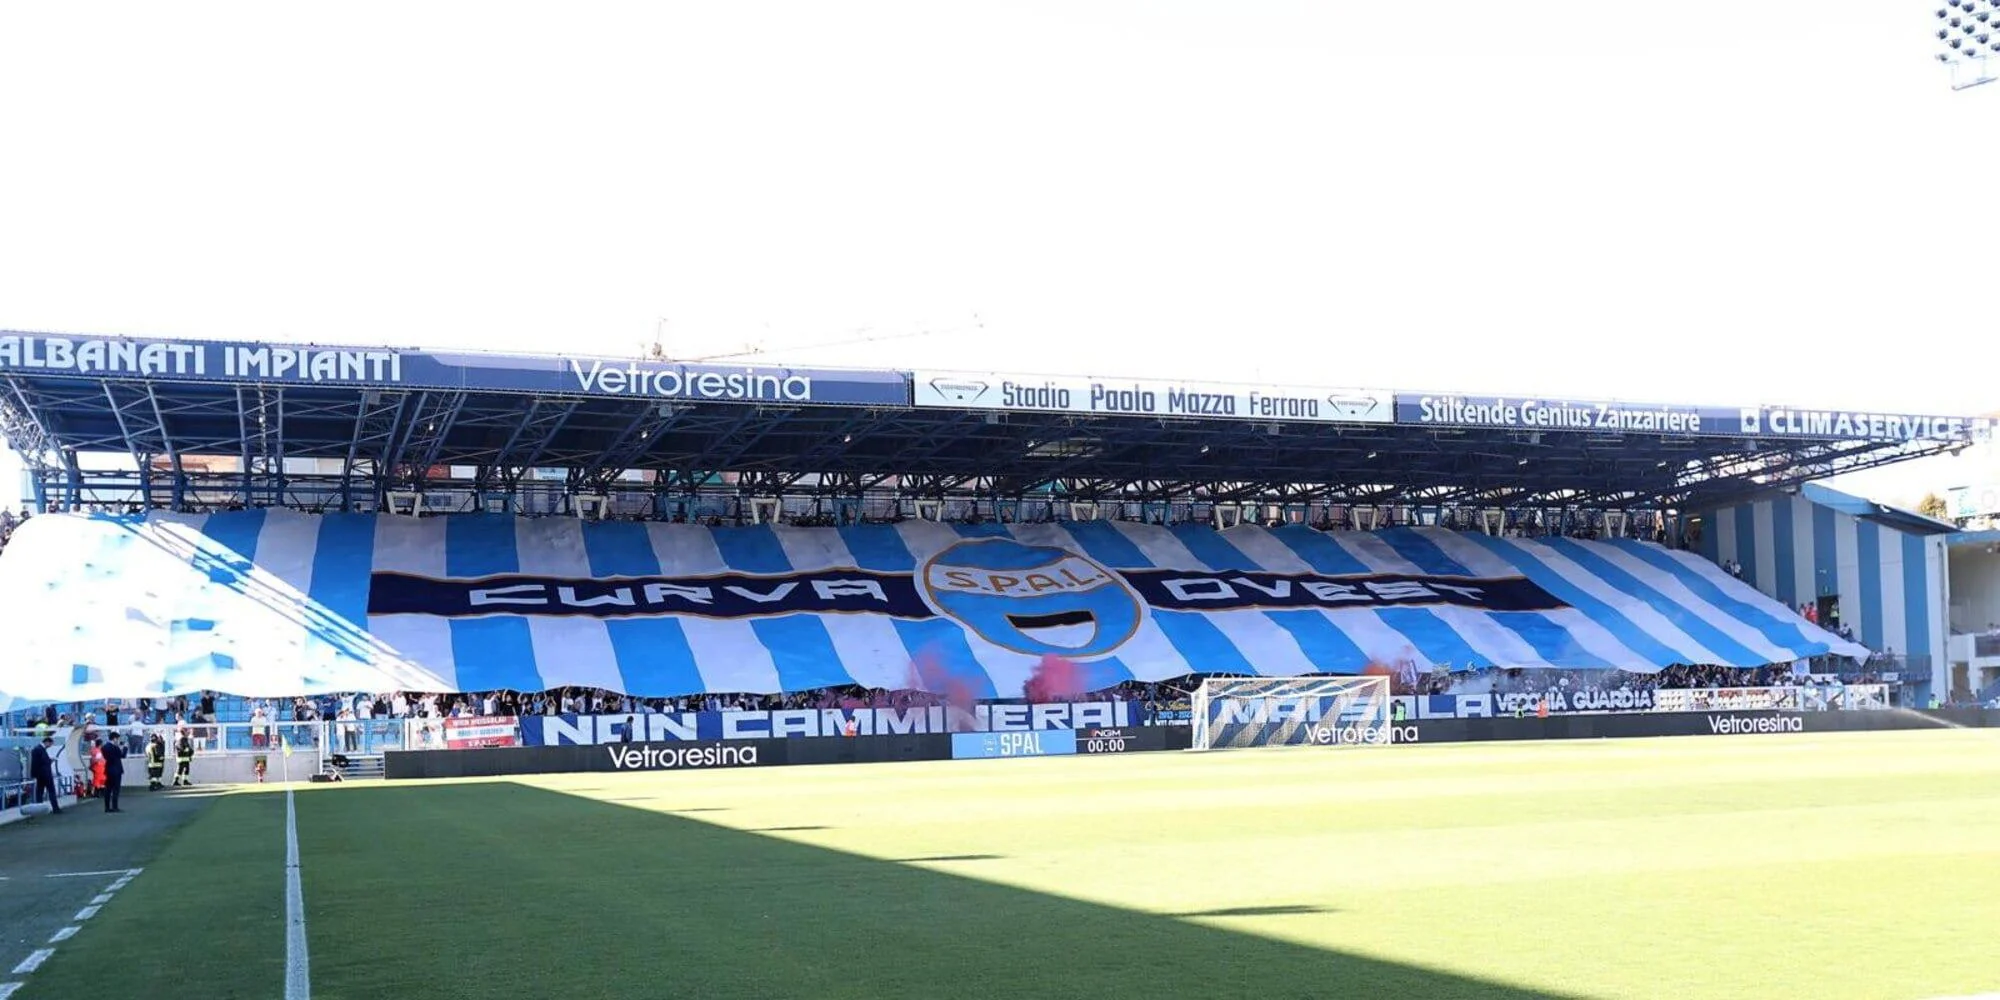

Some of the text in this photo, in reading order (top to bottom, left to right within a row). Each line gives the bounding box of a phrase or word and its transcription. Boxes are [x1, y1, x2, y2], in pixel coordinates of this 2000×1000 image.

[0, 336, 400, 382] ALBANATI IMPIANTI
[570, 359, 811, 400] Vetroresina
[1002, 381, 1318, 417] Stadio Paolo Mazza Ferrara
[1420, 397, 1700, 431] Stiltende Genius Zanzariere
[1769, 410, 1964, 440] CLIMASERVICE
[469, 579, 888, 605] CURVA
[1161, 577, 1486, 601] OVEST
[1572, 691, 1651, 710] GUARDIA
[542, 713, 698, 746] NON
[722, 701, 1129, 740] CAMMINERAI
[1304, 723, 1418, 745] Vetroresna
[1708, 714, 1803, 734] Vetroresina
[608, 744, 758, 768] Vetroresina
[1000, 732, 1045, 756] SPAL
[1088, 739, 1125, 752] 00:00
